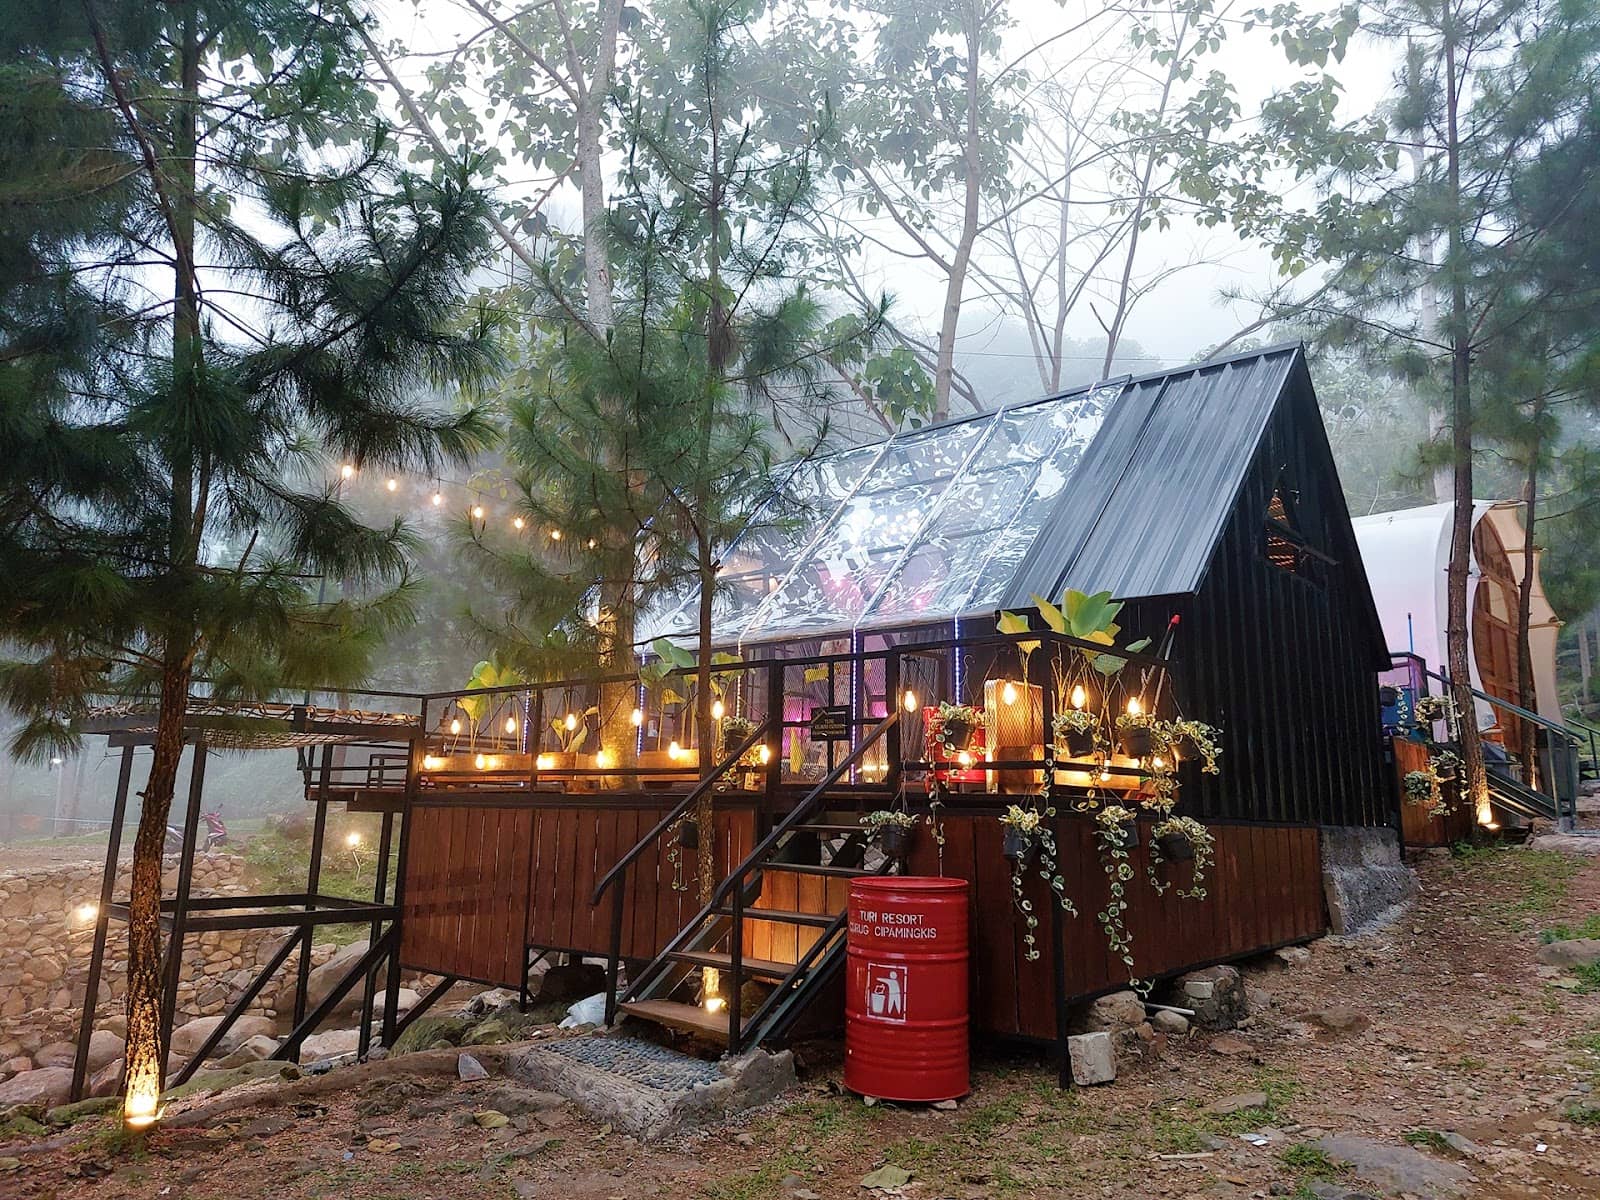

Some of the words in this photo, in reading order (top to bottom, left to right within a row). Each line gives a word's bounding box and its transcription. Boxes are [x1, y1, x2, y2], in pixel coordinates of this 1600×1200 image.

[860, 910, 877, 923] TURI
[882, 913, 924, 925] RESORT
[874, 926, 937, 939] CIPAMINGKIS
